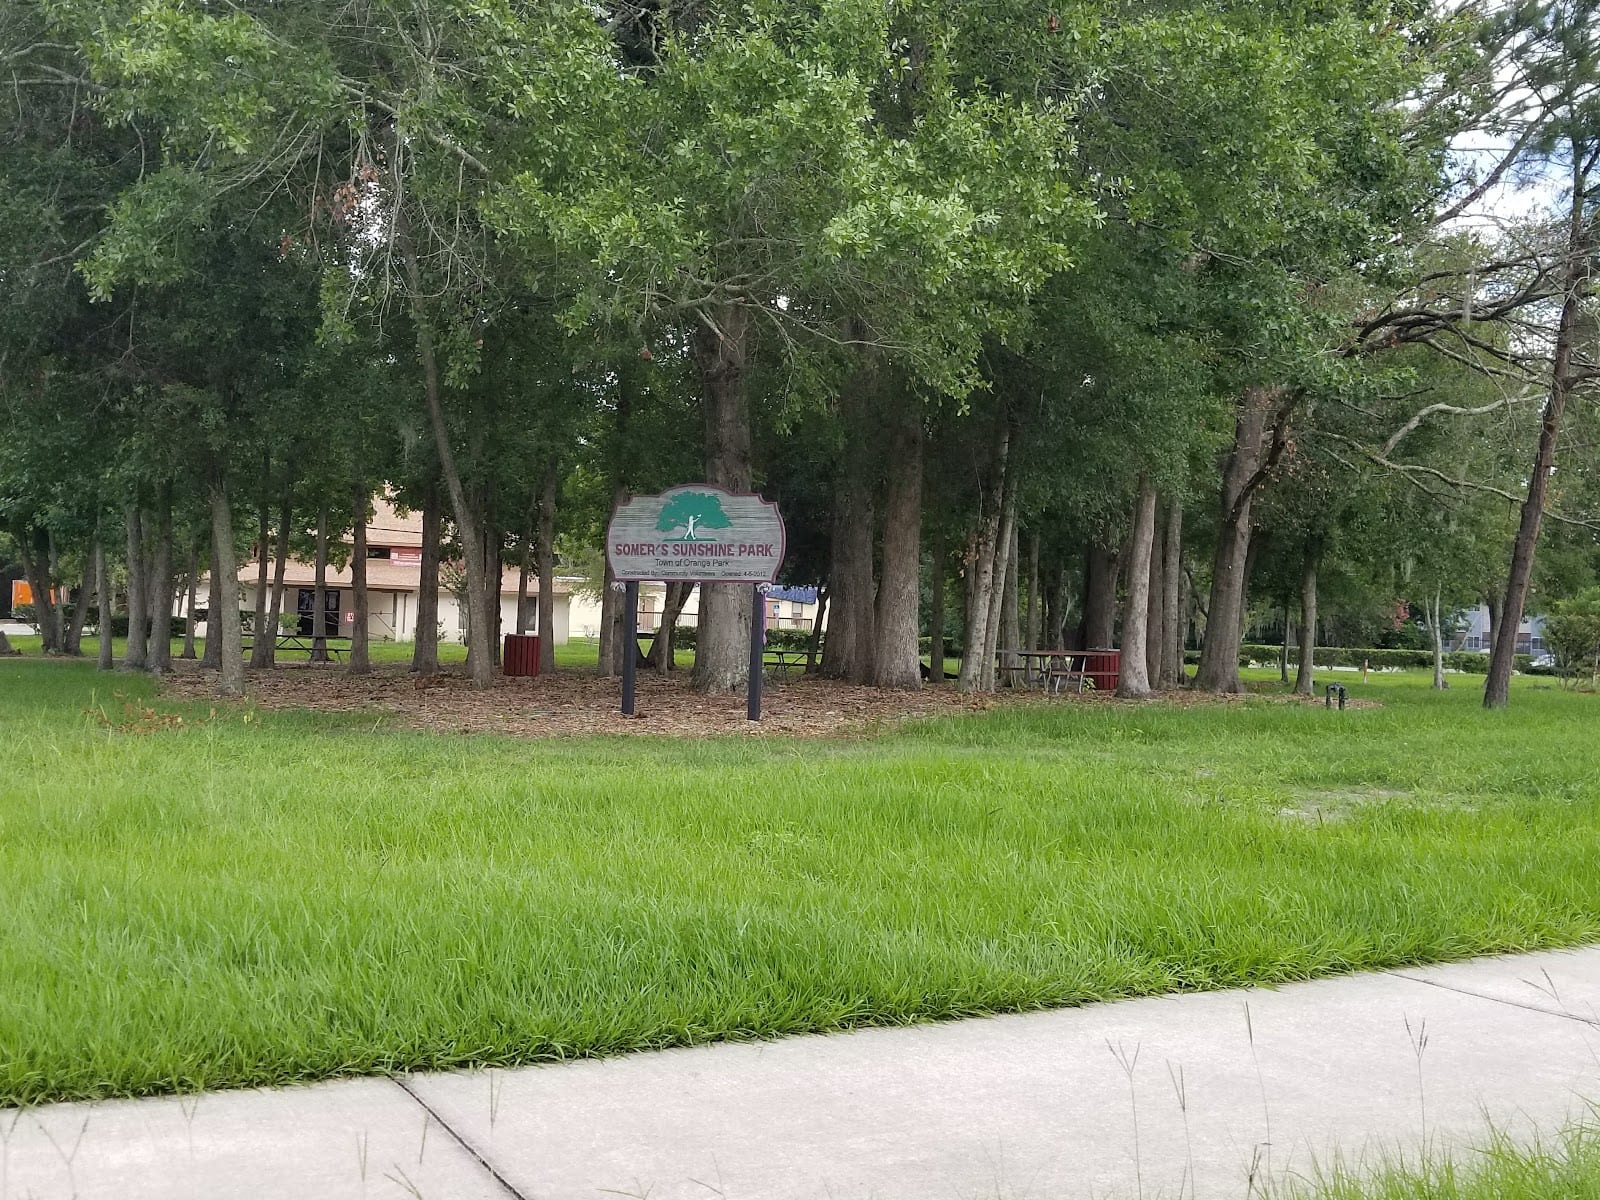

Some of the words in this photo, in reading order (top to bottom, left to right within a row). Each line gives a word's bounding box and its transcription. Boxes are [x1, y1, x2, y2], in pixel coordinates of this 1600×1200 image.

[615, 543, 669, 556] SOMER'S
[672, 543, 735, 556] SUNSHINE
[738, 543, 775, 557] PARK
[655, 558, 674, 567] Town
[675, 558, 683, 567] of
[683, 558, 711, 568] Orange
[712, 558, 730, 567] Park
